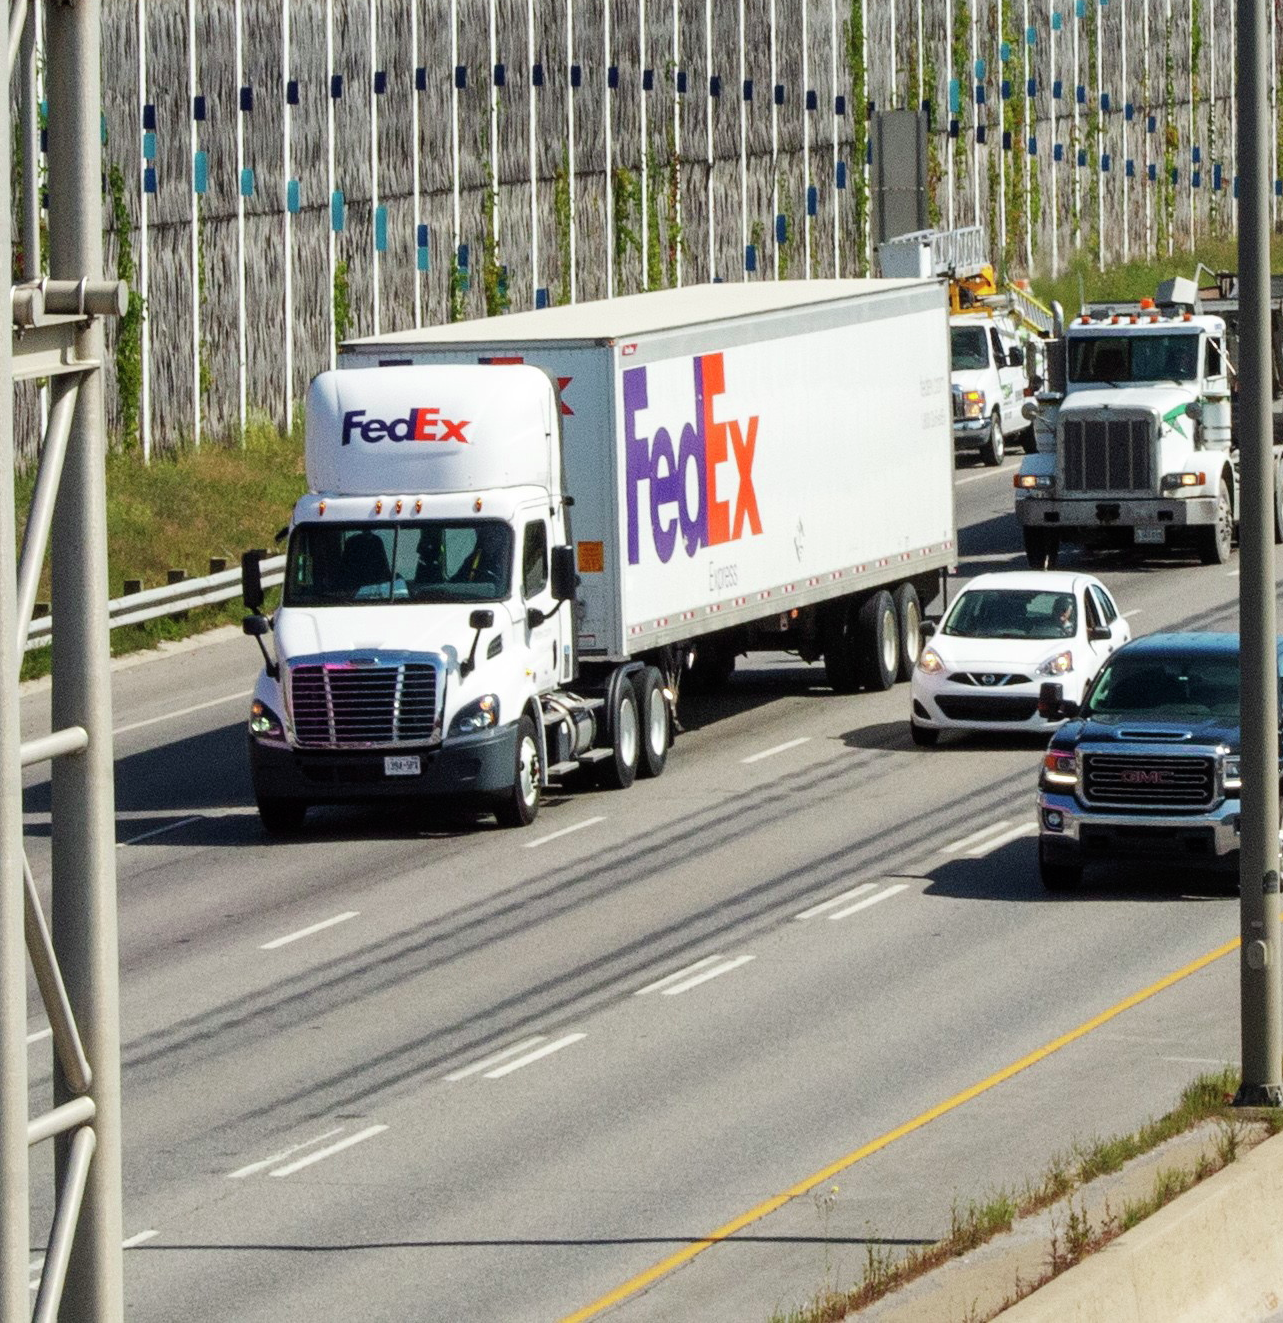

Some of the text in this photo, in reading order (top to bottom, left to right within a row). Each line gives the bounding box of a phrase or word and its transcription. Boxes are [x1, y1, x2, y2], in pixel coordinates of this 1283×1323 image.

[341, 407, 472, 447] FedEx
[622, 352, 764, 565] FedEx
[709, 561, 739, 592] Express
[1120, 770, 1175, 784] GMC
